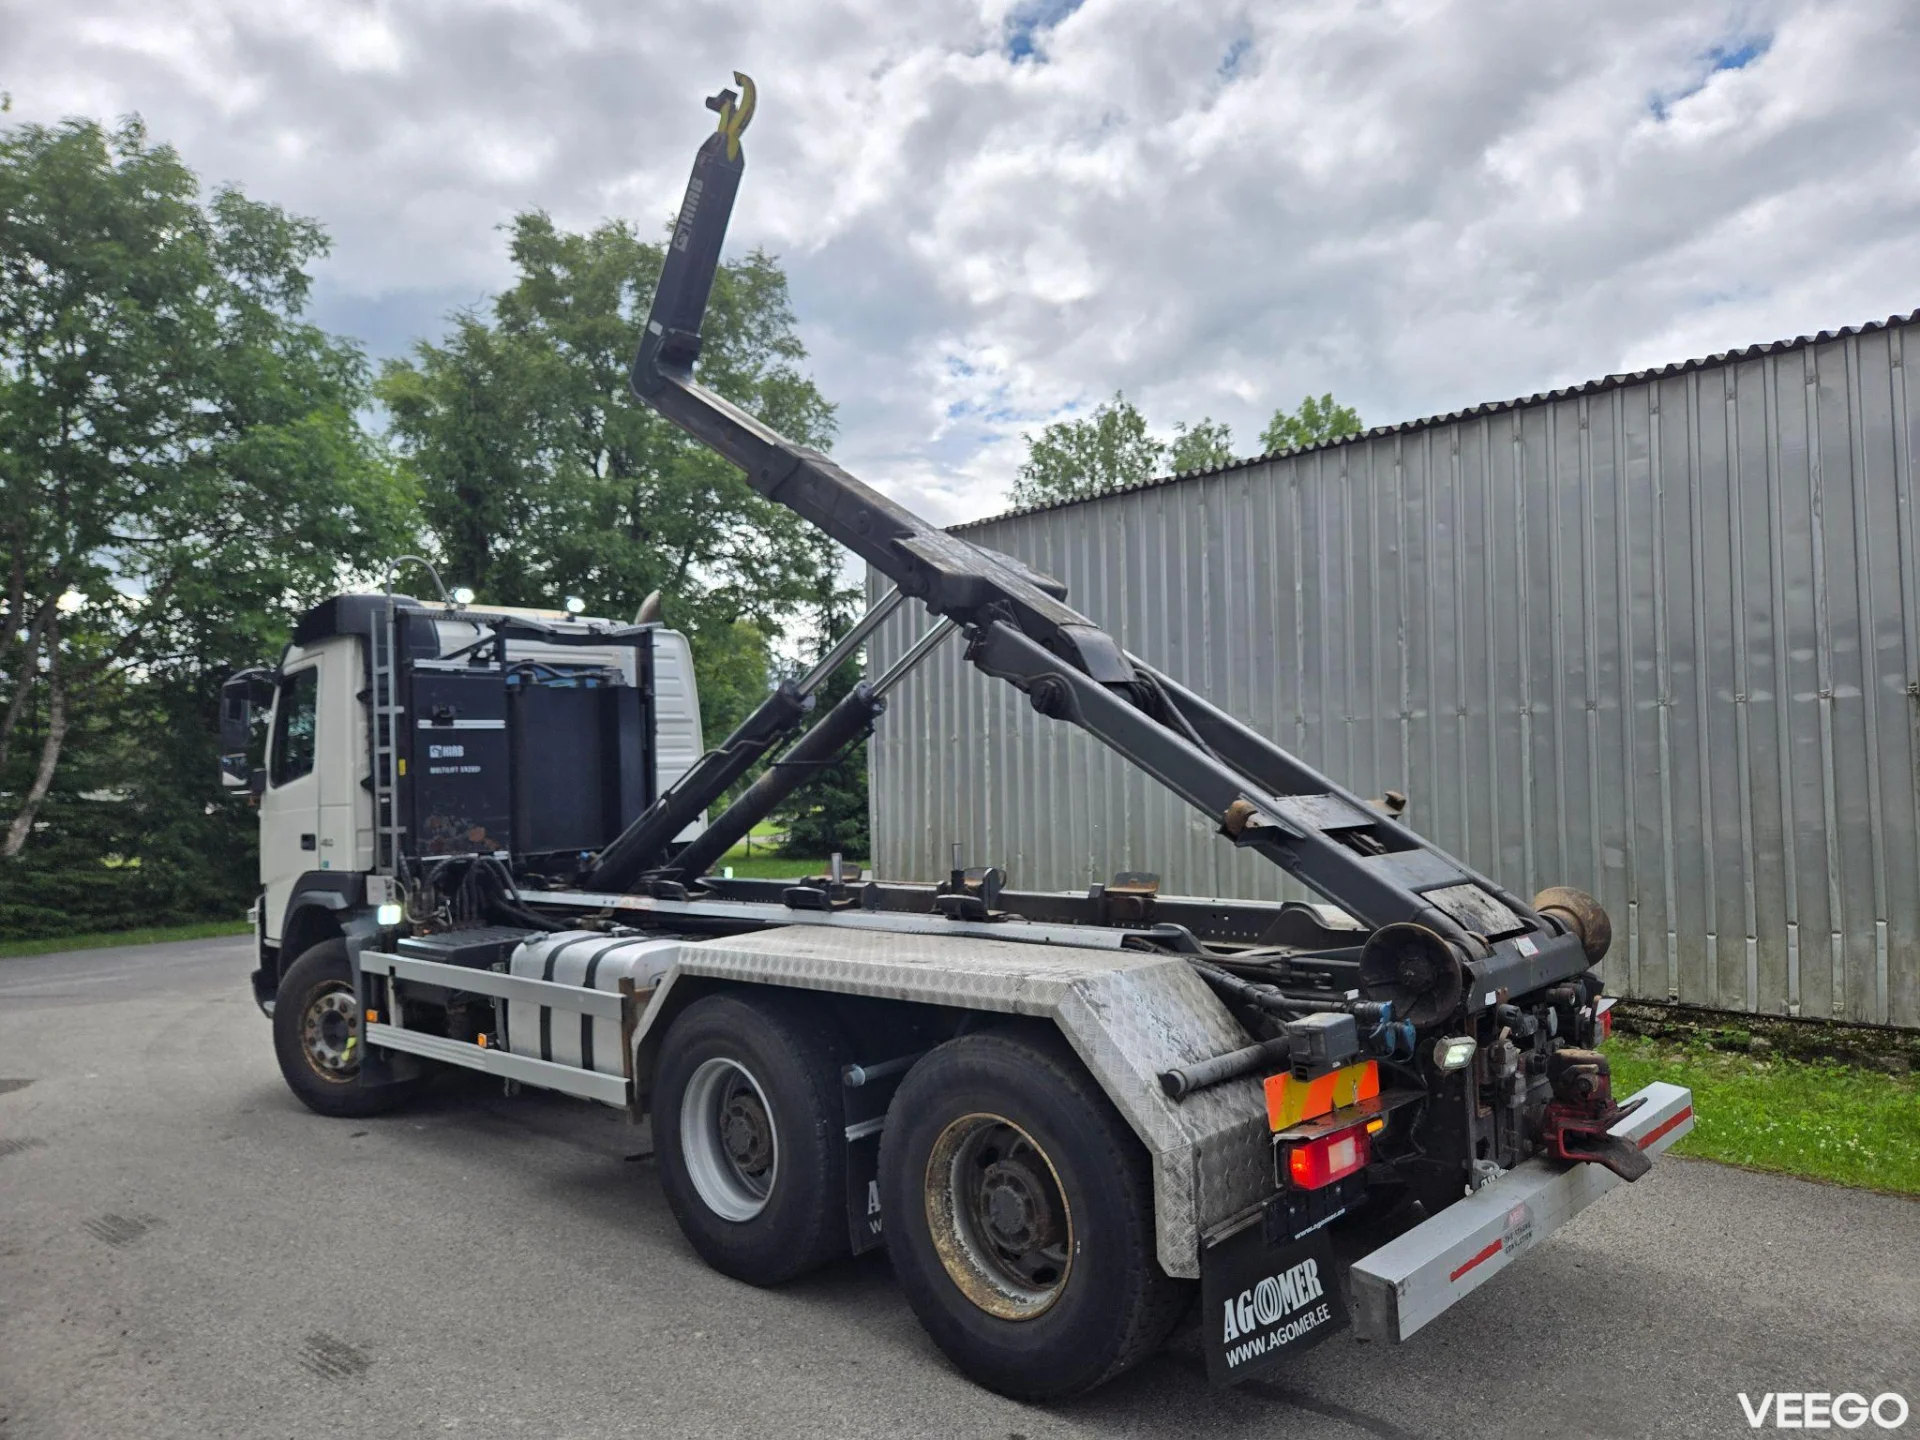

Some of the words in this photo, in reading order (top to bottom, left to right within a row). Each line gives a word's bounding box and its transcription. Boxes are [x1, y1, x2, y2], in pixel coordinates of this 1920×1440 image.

[681, 177, 703, 226] HIAB
[1294, 1207, 1346, 1240] www.agomer.ee
[1223, 1258, 1324, 1344] AGOMER
[1225, 1303, 1331, 1368] WWW.AGOMER.EE
